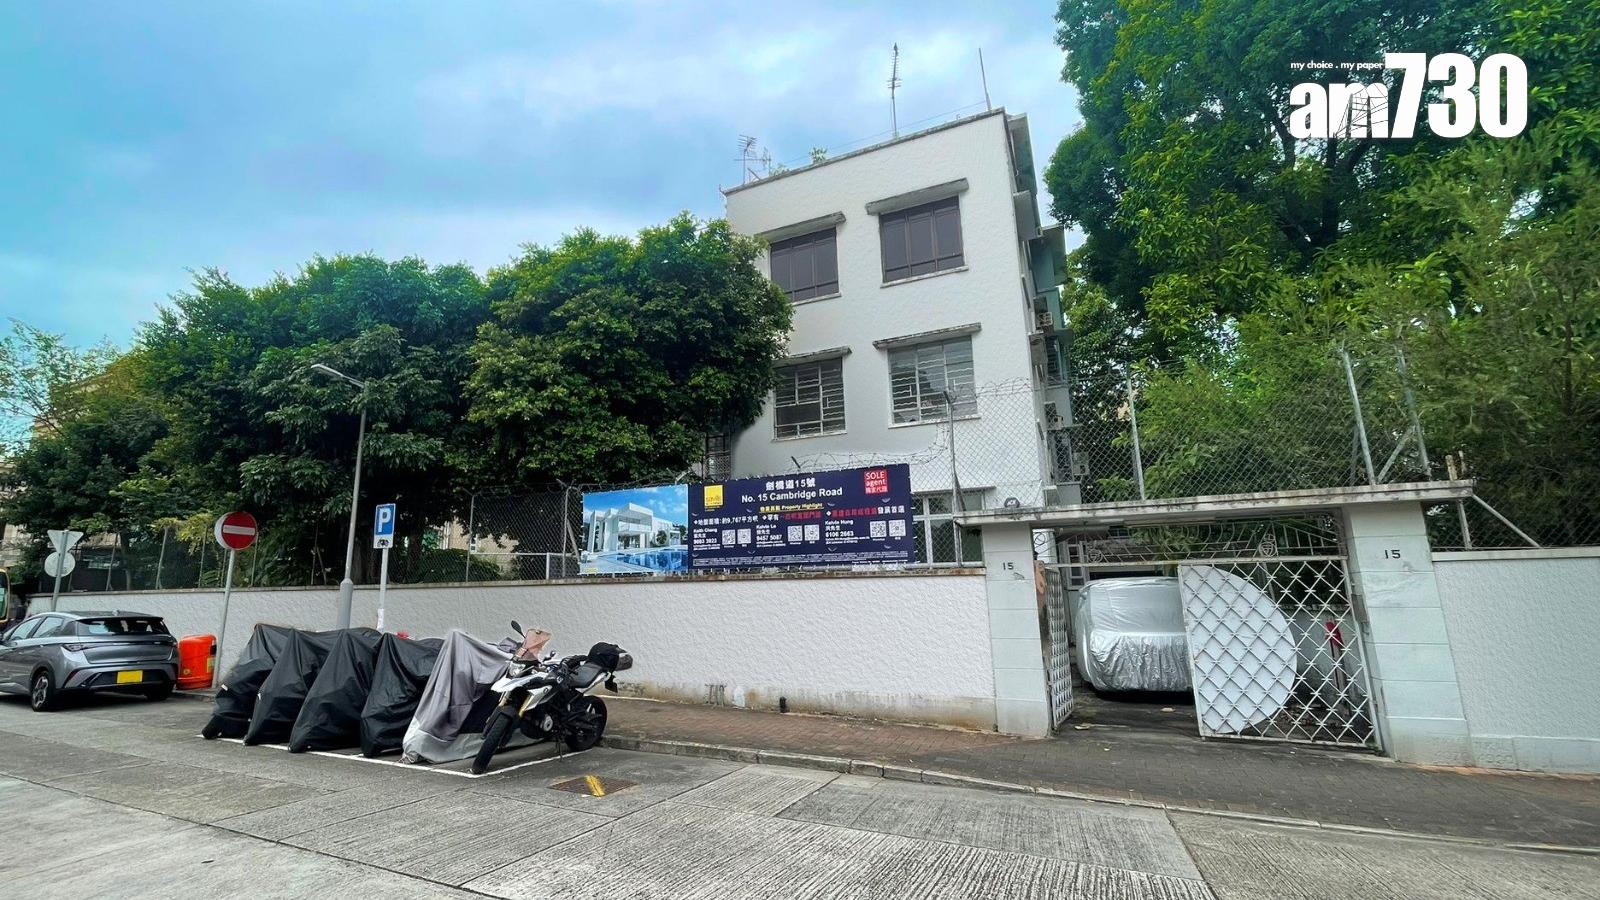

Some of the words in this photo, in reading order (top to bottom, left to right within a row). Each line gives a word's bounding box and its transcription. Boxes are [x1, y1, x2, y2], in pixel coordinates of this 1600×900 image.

[865, 470, 885, 480] SOLE
[865, 478, 887, 487] agent
[741, 494, 756, 504] No.
[758, 493, 768, 502] 15
[769, 490, 817, 501] Cambridge
[819, 487, 843, 497] Road
[378, 507, 391, 533] P
[1385, 549, 1401, 559] 15
[1002, 562, 1014, 570] 15
